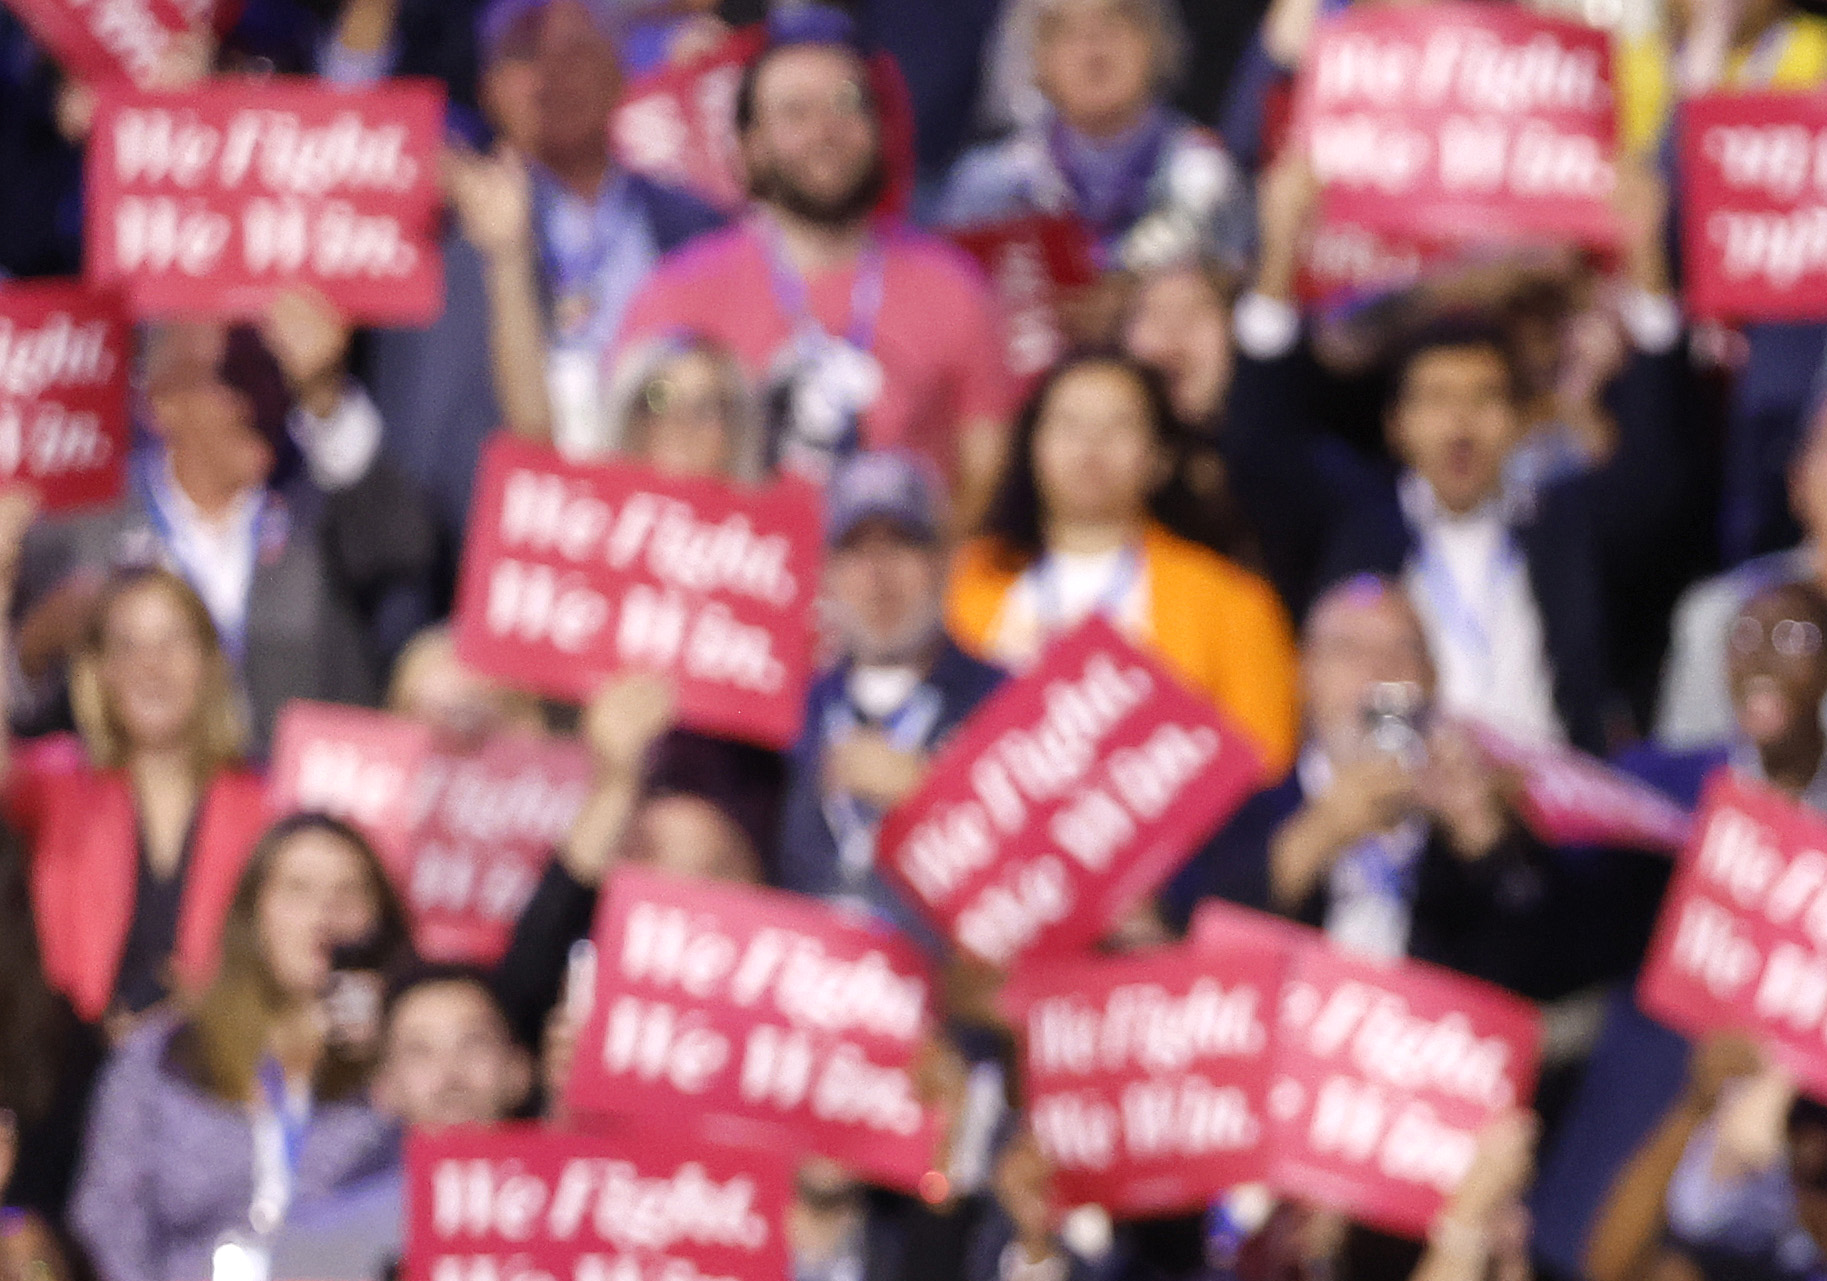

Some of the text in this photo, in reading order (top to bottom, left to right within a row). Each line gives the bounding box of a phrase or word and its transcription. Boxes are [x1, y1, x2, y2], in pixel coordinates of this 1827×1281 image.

[1317, 31, 1417, 98] We
[112, 108, 418, 190] We Fight.
[1311, 113, 1616, 197] We Win.
[113, 198, 416, 276] We Win.
[500, 468, 799, 607] We Fight.
[486, 556, 785, 693] We Win.
[900, 650, 1155, 902] We Fight.
[954, 720, 1221, 966] We Win.
[1696, 798, 1788, 897] We
[620, 899, 738, 999] We
[1671, 893, 1763, 999] We
[601, 993, 924, 1138] We Win.
[428, 1157, 769, 1256] We Fight.
